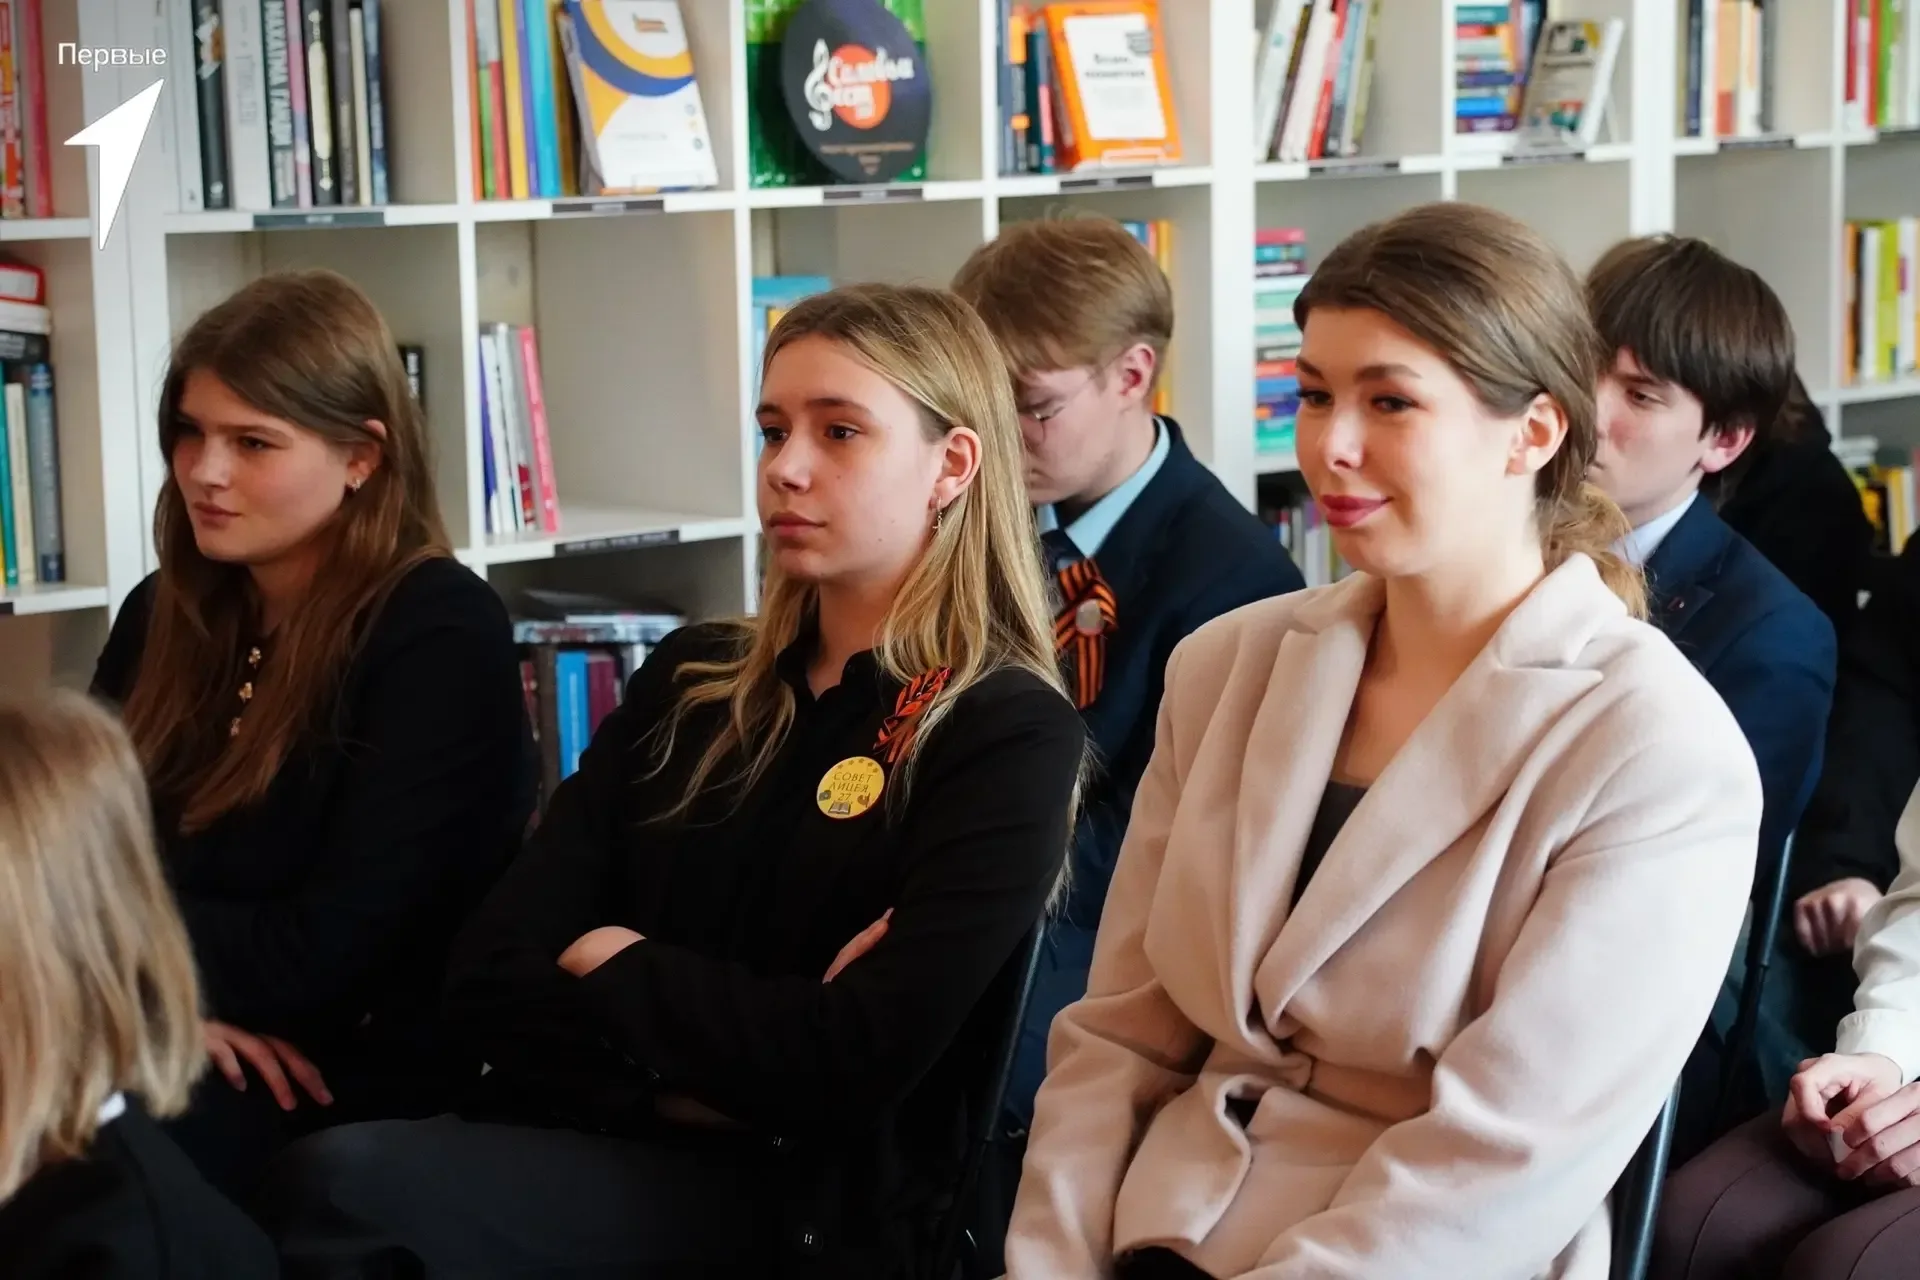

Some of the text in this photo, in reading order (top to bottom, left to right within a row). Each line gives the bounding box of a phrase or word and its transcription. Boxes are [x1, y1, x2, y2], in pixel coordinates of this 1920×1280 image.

[834, 772, 873, 782] СОВЕТ
[829, 782, 869, 793] ЛИЦЕЯ
[838, 793, 852, 801] 27
